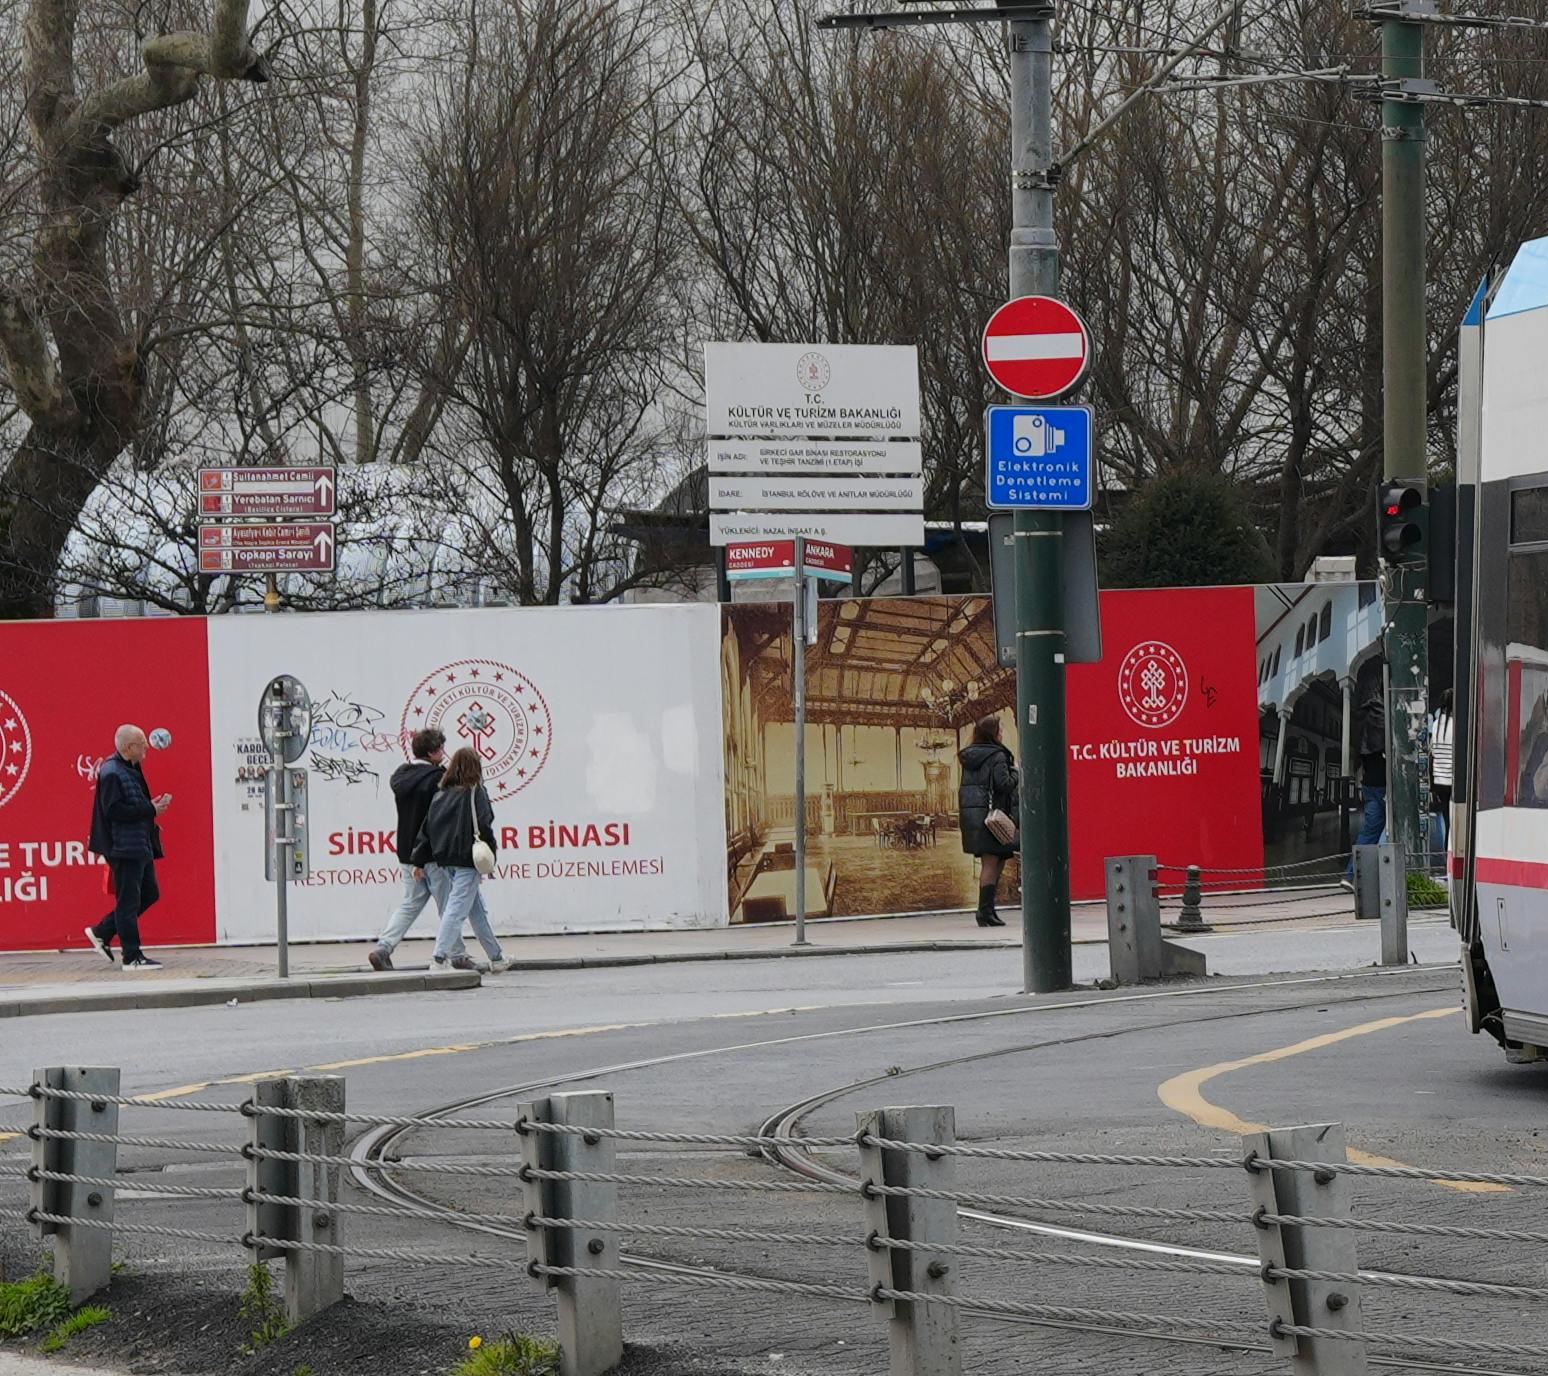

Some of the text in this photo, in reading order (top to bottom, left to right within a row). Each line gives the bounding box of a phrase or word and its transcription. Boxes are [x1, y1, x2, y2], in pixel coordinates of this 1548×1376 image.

[805, 394, 825, 404] T.C.
[728, 405, 901, 419] KÜLTÜR VE TURİZM BAKANLIĞI
[998, 461, 1080, 472] Elektronik
[996, 475, 1081, 486] Denetleme
[1008, 489, 1068, 500] Sistemi
[729, 546, 774, 560] KENNEDY
[806, 544, 835, 559] ANKARA
[458, 685, 495, 697] KÜLTÜR
[497, 692, 508, 704] VE
[1070, 735, 1240, 760] T.C. KÜLTÜR VE TURİZM
[1116, 757, 1197, 778] BAKANLIĞI
[328, 826, 397, 856] SİRK
[528, 819, 630, 850] BİNASI
[0, 835, 108, 868] E TURİ
[294, 867, 401, 886] RESTORASY
[537, 856, 664, 879] DÜZENLEMESİ
